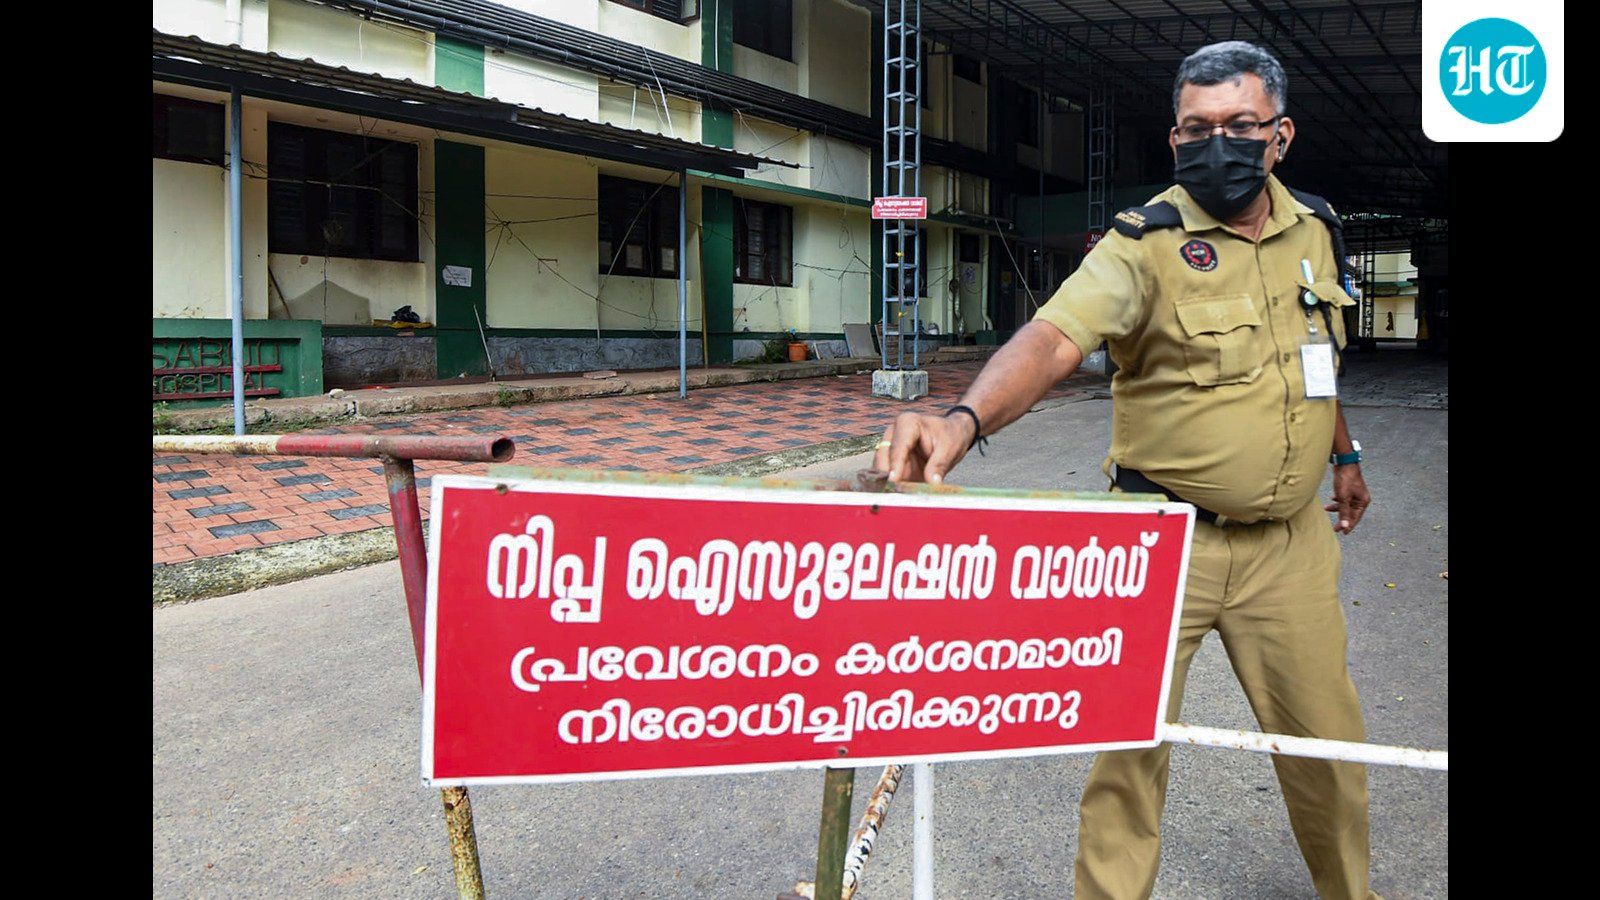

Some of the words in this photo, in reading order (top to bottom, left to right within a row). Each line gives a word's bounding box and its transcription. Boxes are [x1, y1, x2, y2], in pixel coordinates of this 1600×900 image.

[486, 514, 607, 623] നിപ്പ
[626, 534, 998, 620] ഐസുലേഷൻ
[1010, 531, 1160, 600] വാർഡ്
[510, 641, 820, 693] പ്രവേശനം
[834, 627, 1123, 678] കർശനമായി
[557, 688, 1082, 744] നിരോധിച്ചിരിക്കുന്നു
